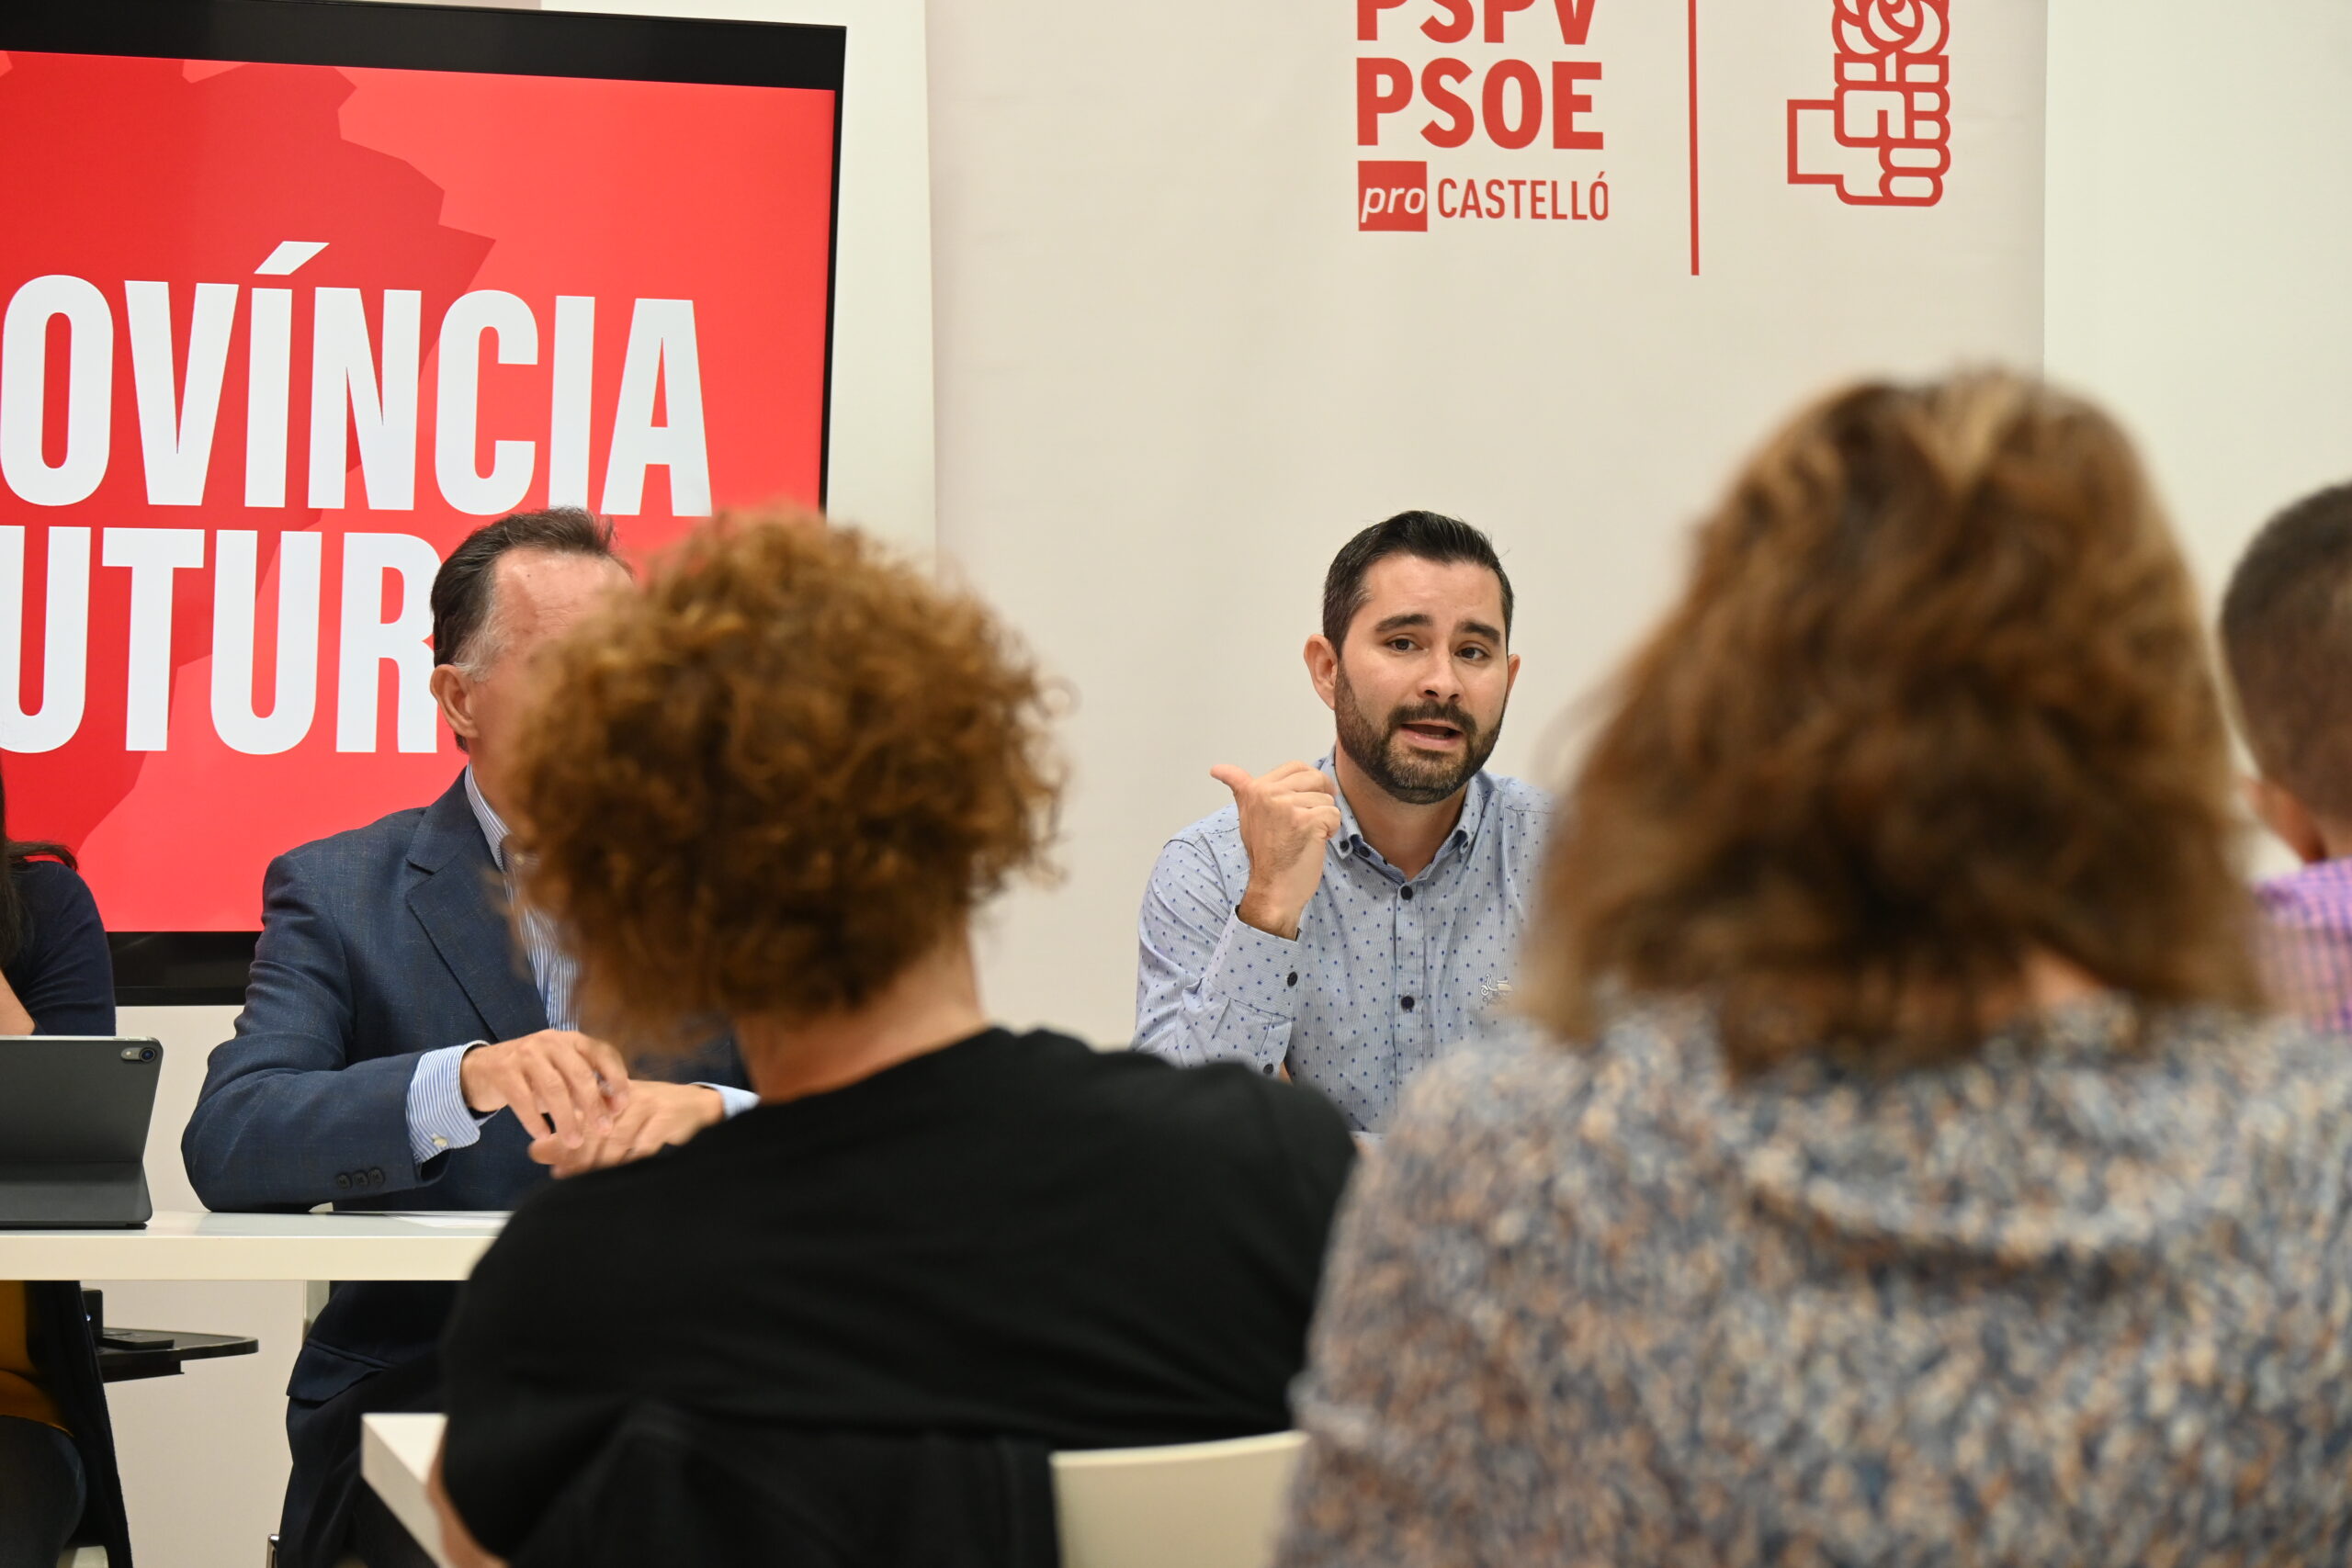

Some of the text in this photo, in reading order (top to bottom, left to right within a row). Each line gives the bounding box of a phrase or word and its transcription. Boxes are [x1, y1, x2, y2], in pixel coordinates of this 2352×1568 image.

[1356, 56, 1604, 151] PSOE
[1360, 171, 1610, 223] pro CASTELLÓ
